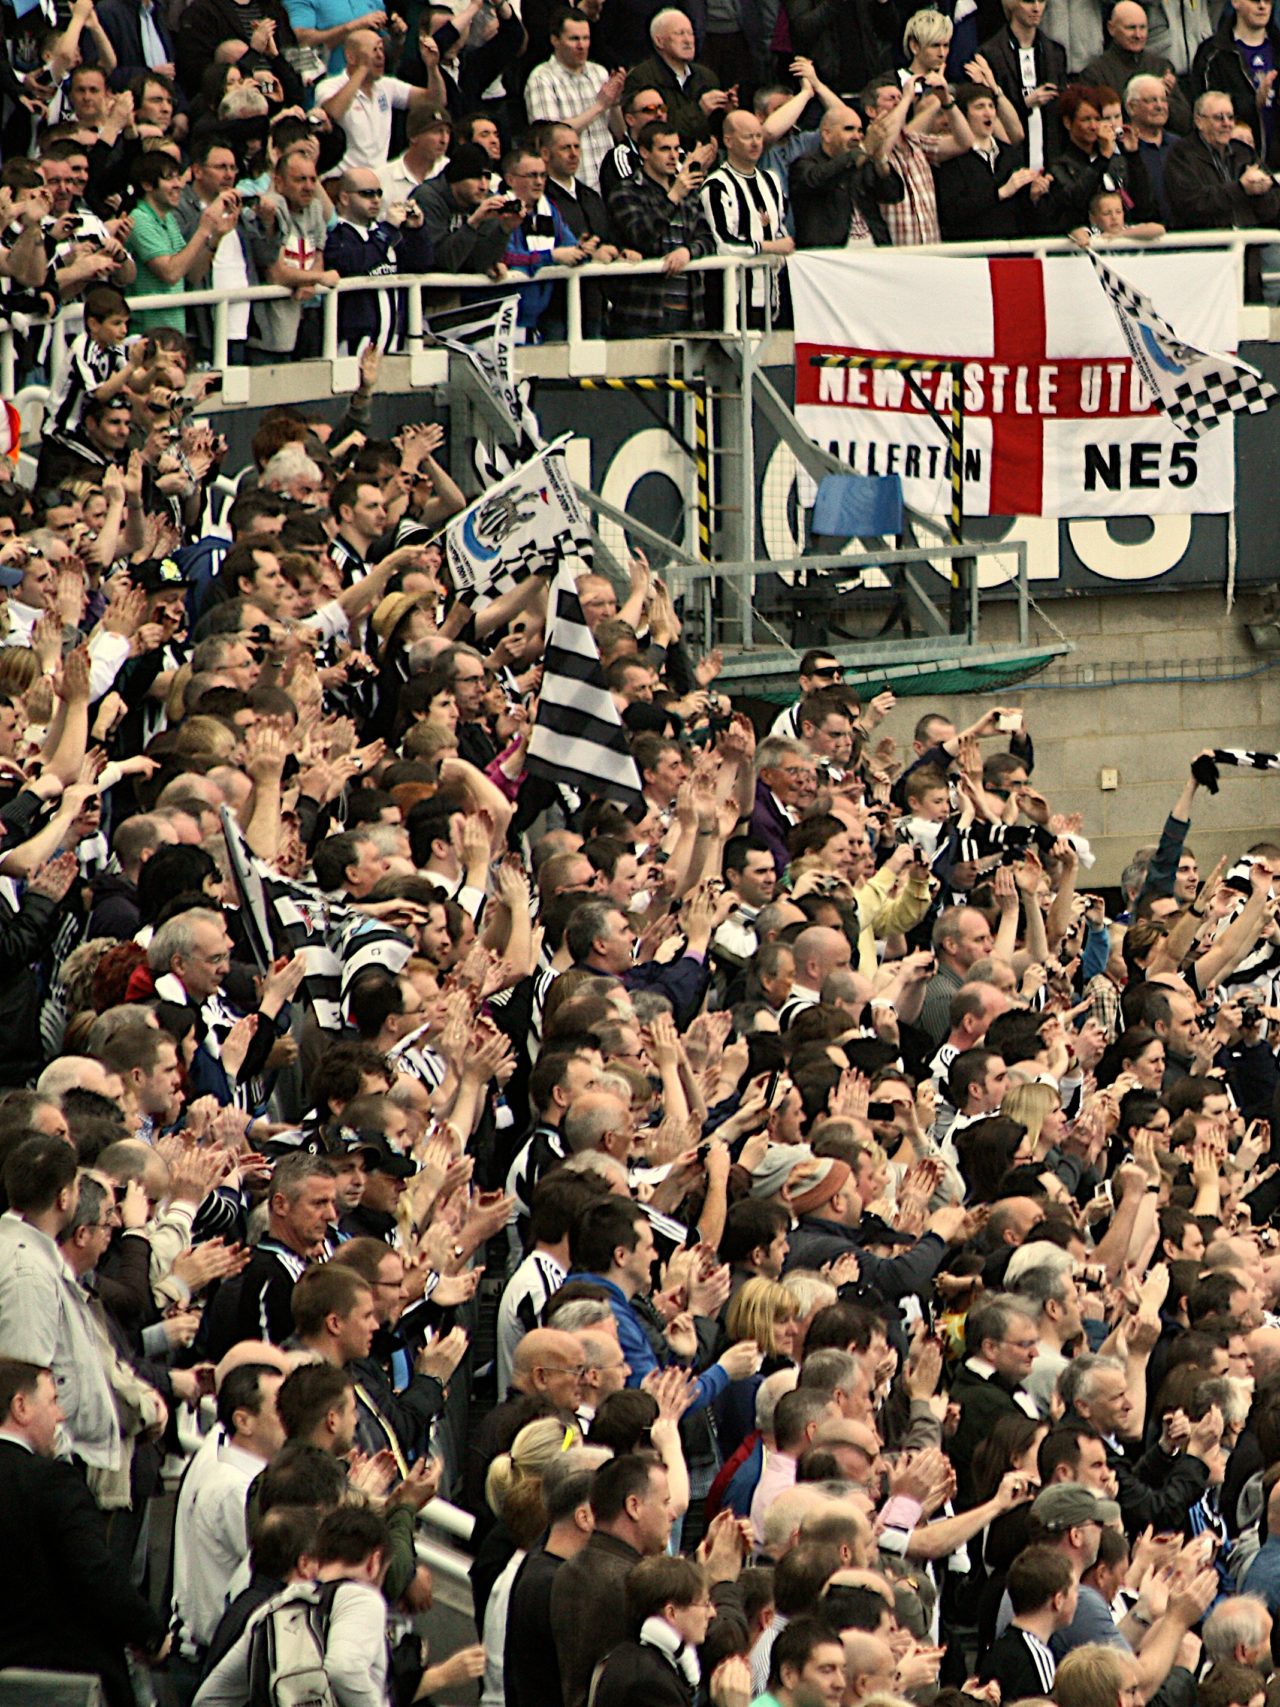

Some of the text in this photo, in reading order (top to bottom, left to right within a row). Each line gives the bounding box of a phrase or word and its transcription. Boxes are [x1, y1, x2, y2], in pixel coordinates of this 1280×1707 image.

[819, 354, 1058, 414] NEWCASTLE
[811, 439, 1198, 491] ALLERTN NE5
